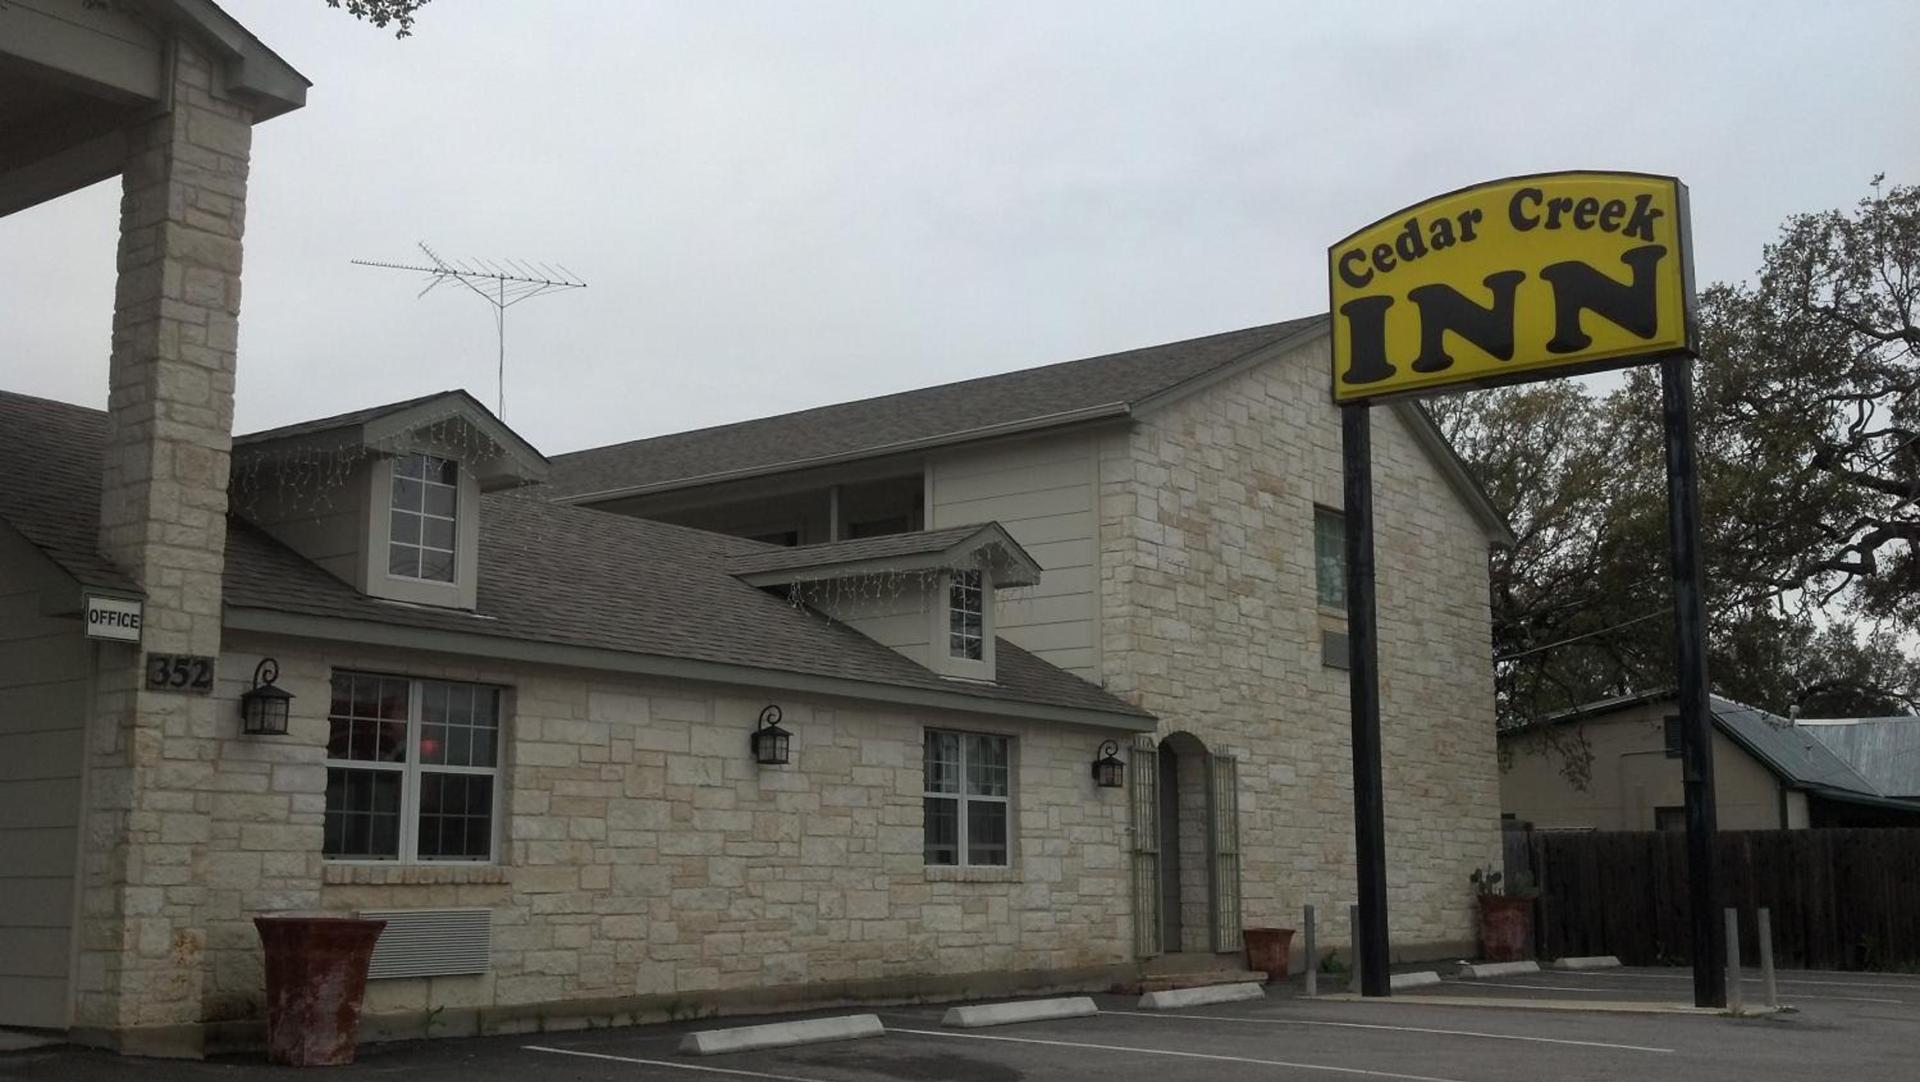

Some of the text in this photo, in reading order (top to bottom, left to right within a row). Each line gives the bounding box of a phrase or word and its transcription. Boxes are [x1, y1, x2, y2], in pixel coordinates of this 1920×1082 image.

[1339, 188, 1665, 288] Cedar Creek
[1340, 245, 1667, 385] INN
[89, 609, 140, 629] OFFICE
[150, 657, 209, 688] 352
